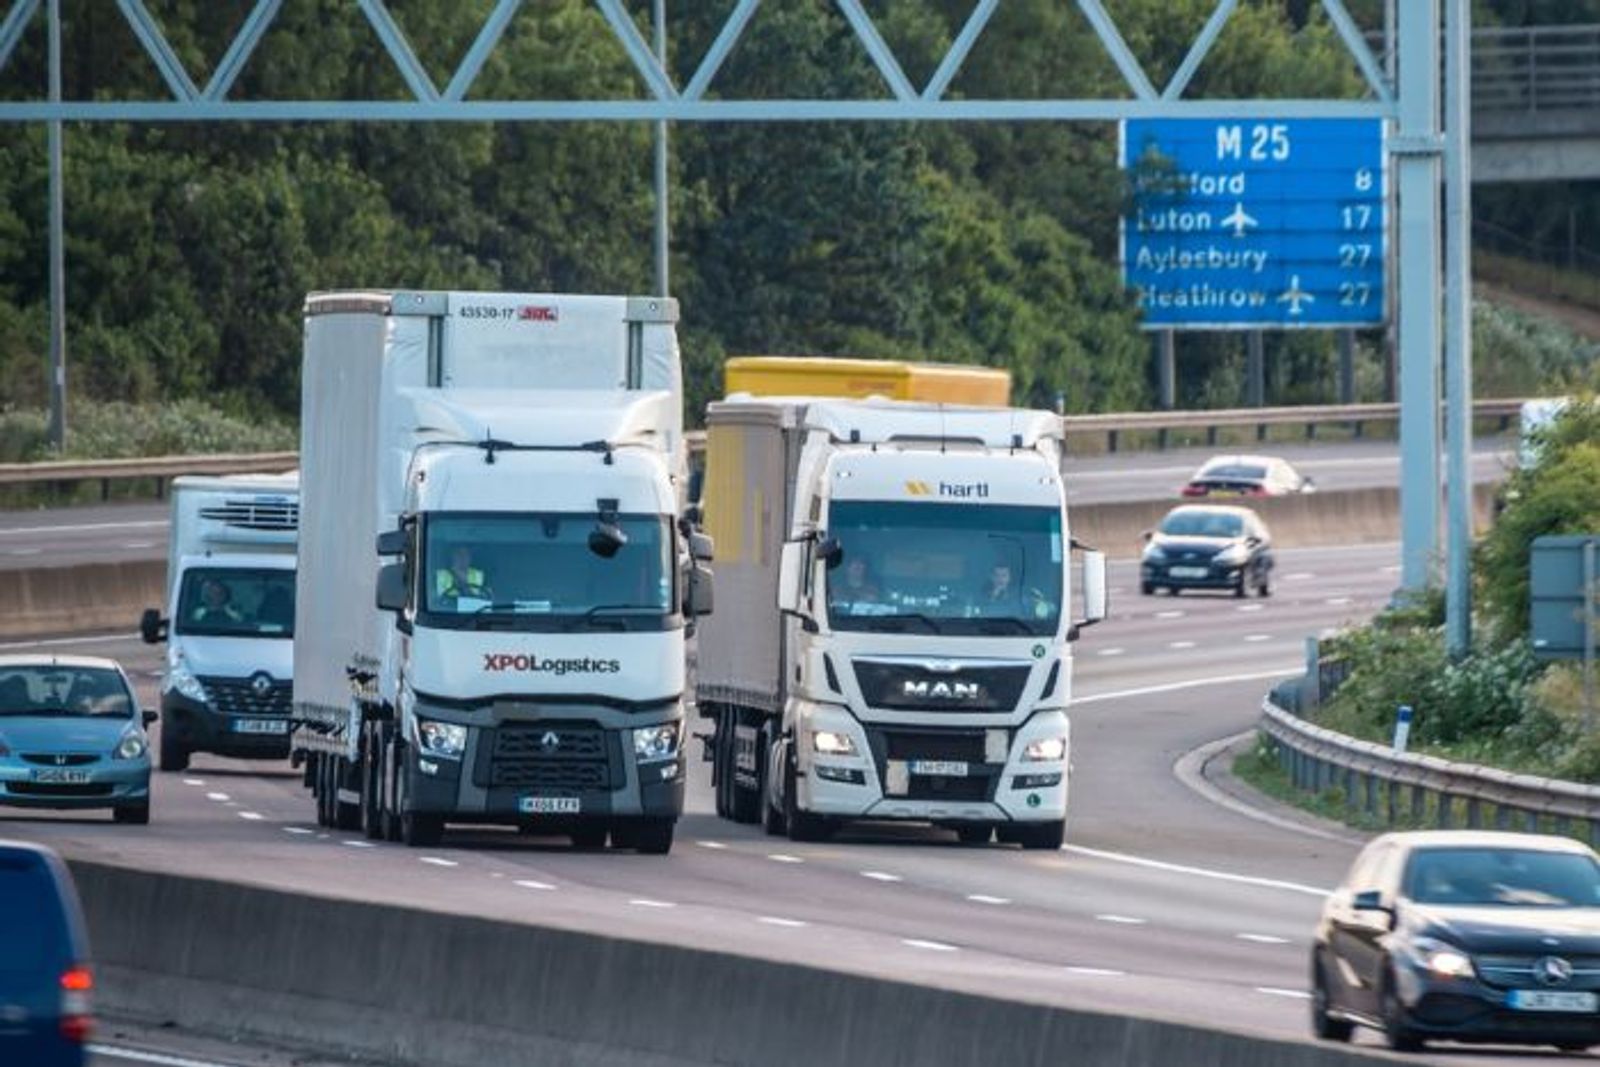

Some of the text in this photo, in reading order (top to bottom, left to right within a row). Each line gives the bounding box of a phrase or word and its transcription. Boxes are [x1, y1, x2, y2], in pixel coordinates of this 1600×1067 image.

[1217, 124, 1290, 160] M 25
[1137, 167, 1373, 195] ford 8
[1342, 204, 1372, 229] 17
[1137, 243, 1372, 274] Aylesbury 27
[1339, 282, 1371, 306] 27
[939, 480, 989, 498] hartl
[903, 680, 979, 699] MAN
